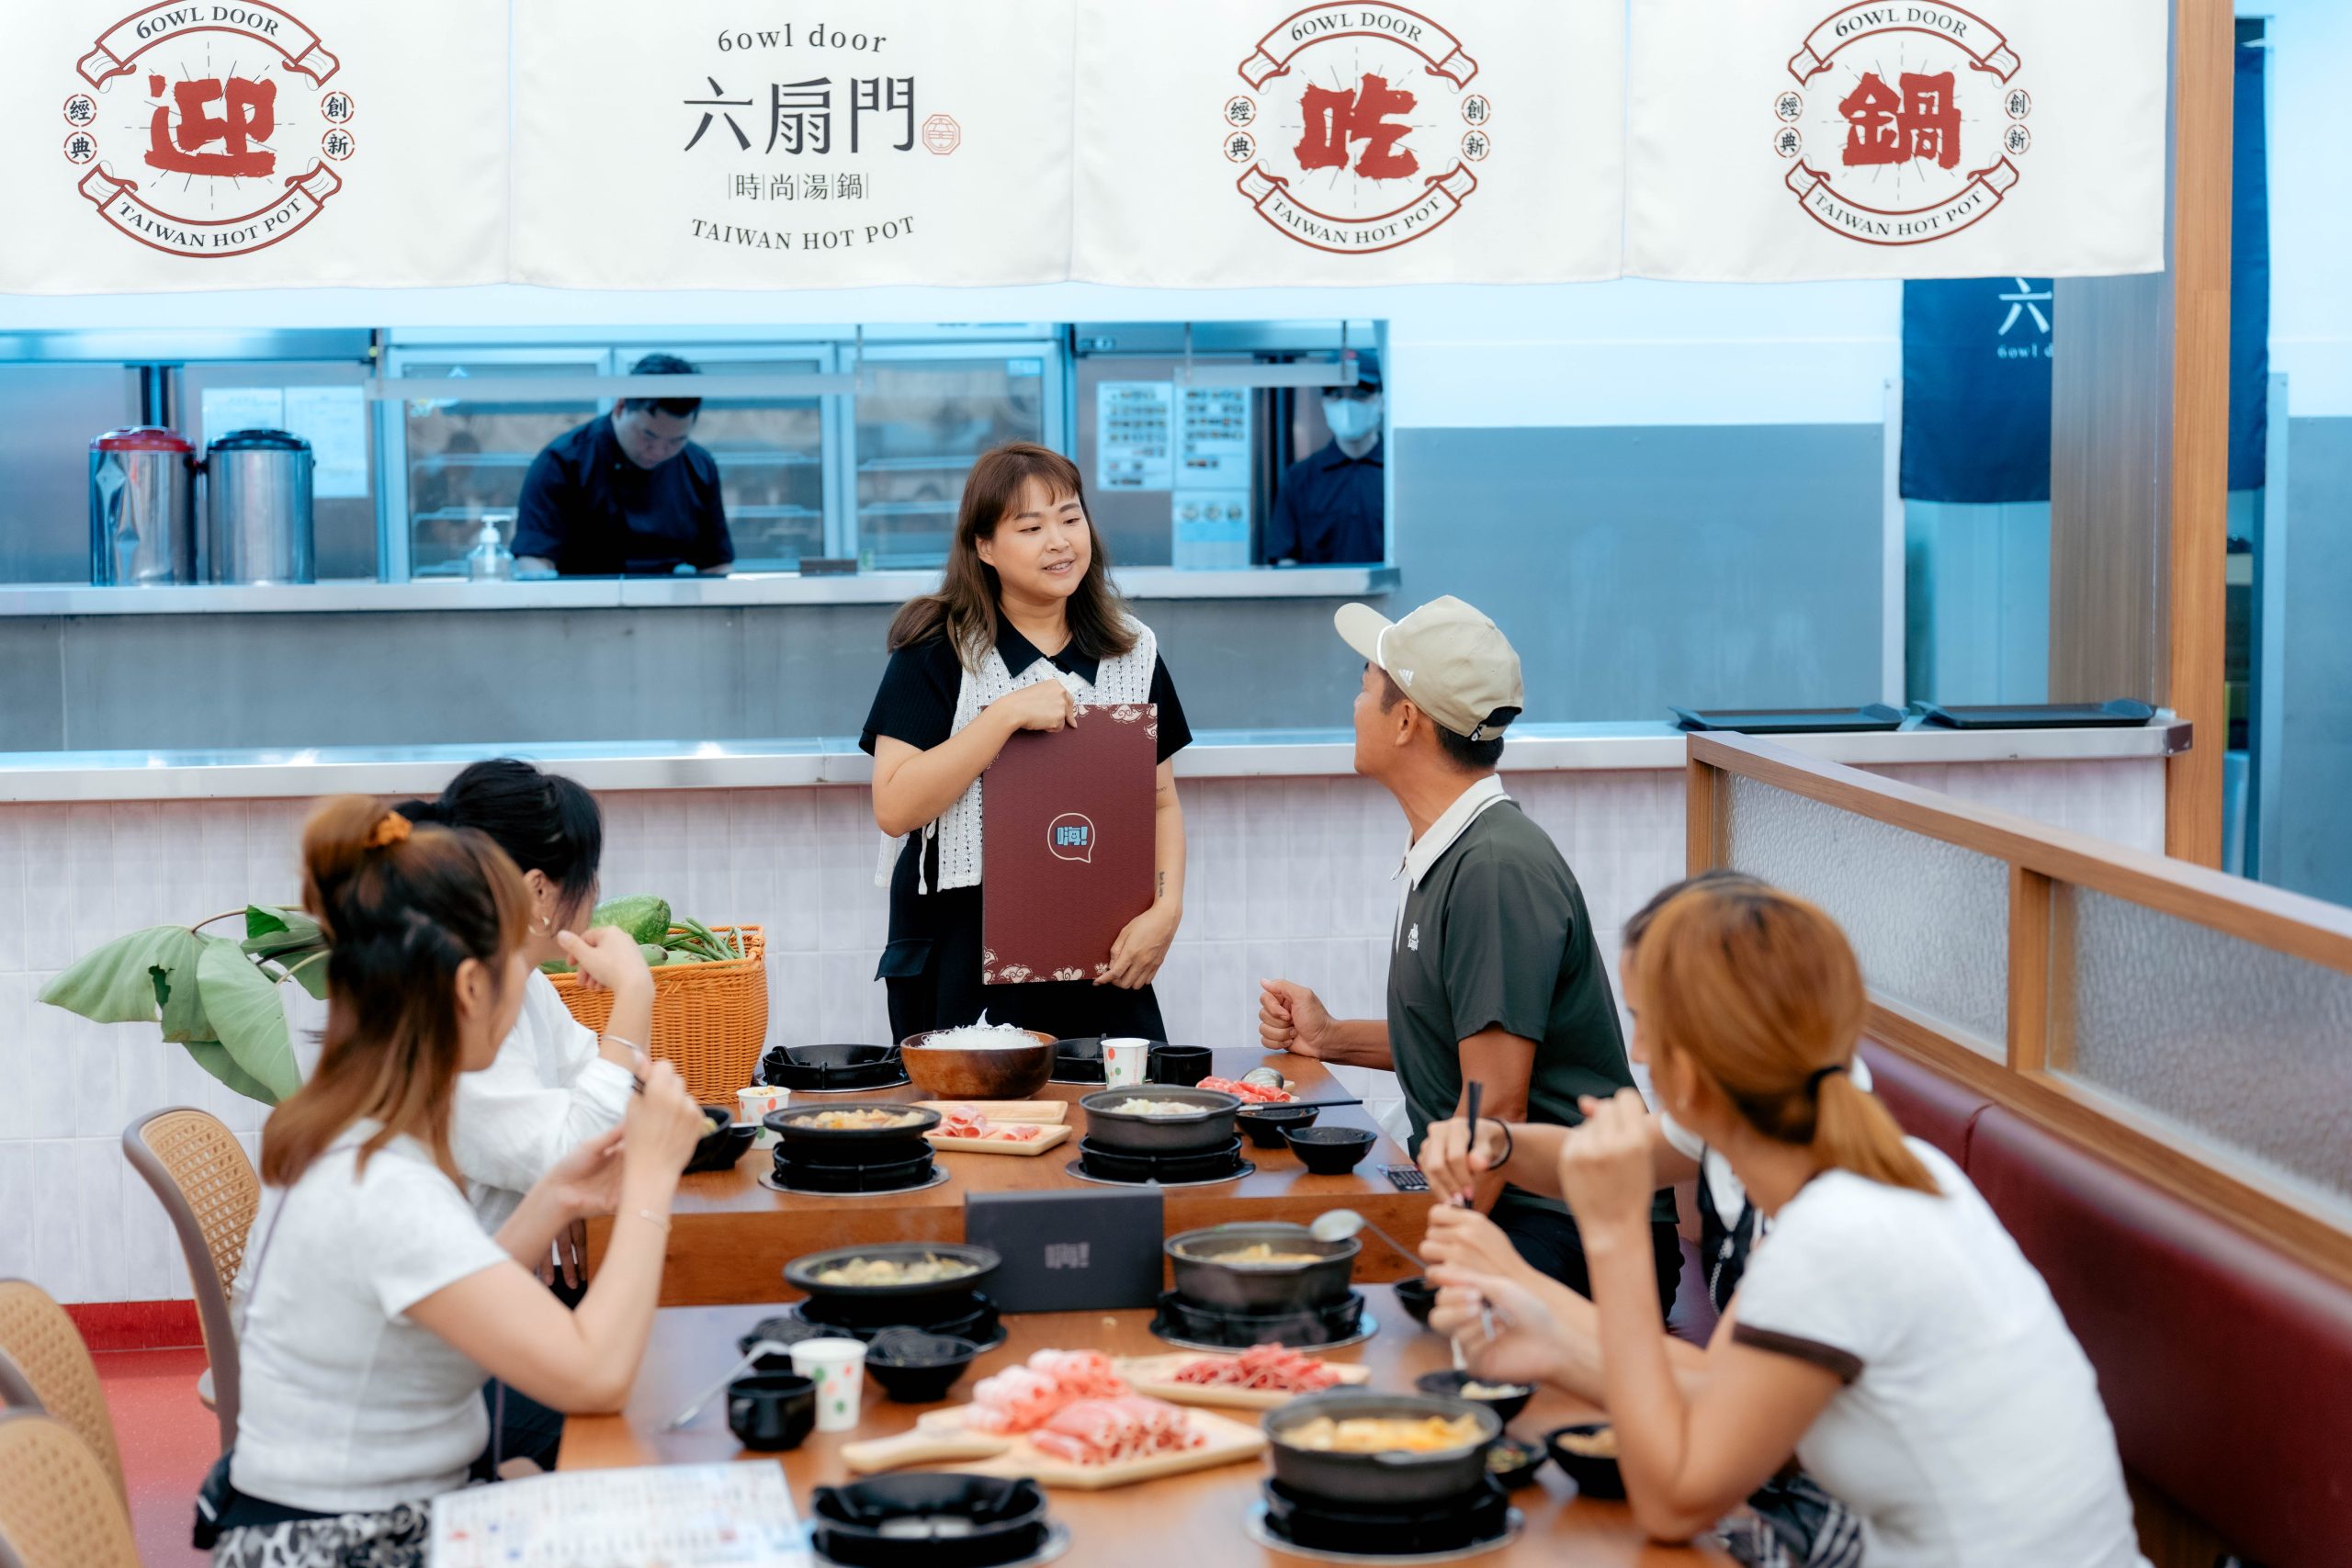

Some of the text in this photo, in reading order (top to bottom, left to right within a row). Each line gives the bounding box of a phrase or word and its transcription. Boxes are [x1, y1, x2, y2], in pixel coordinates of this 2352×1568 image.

[136, 6, 279, 39] 6OWL DOOR
[718, 23, 887, 52] 6owl door
[1291, 12, 1422, 42] 6OWL DOOR
[1835, 7, 1967, 38] 6OWL DOOR
[143, 74, 277, 178] 迎
[683, 75, 914, 155] 六扇門
[1293, 72, 1420, 181] 吃
[1838, 71, 1962, 170] 鍋
[735, 173, 863, 200] 時尚湯鍋
[119, 197, 302, 247] TAIWAN HOT POT
[691, 216, 914, 250] TAIWAN HOT POT
[1272, 197, 1442, 243] TAIWAN HOT POT
[1815, 190, 1984, 236] TAIWAN HOT POT
